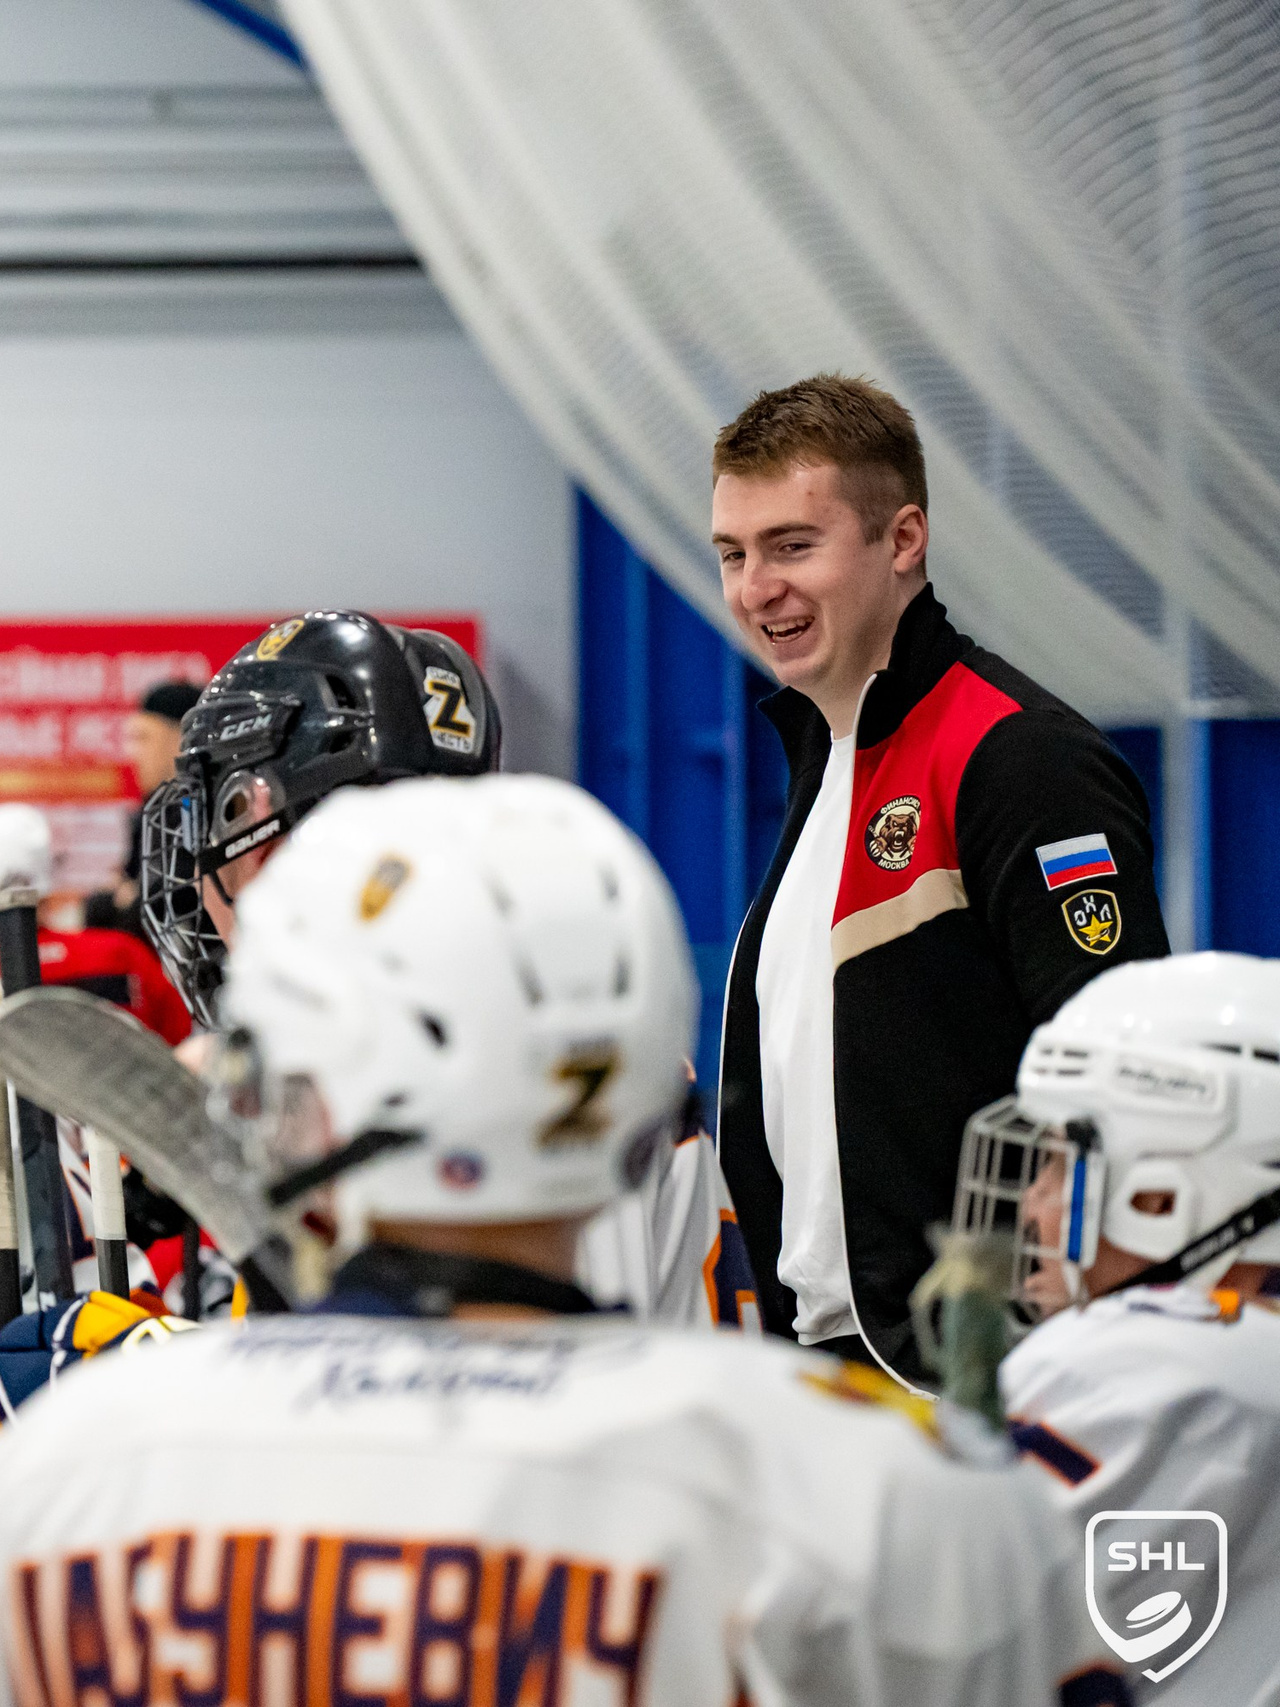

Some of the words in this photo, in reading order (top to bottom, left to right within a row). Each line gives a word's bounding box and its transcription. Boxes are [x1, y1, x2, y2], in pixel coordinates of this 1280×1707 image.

[428, 679, 471, 738] Z
[220, 714, 272, 742] CCM
[225, 819, 281, 859] BAUER
[878, 858, 910, 870] МОСКВА
